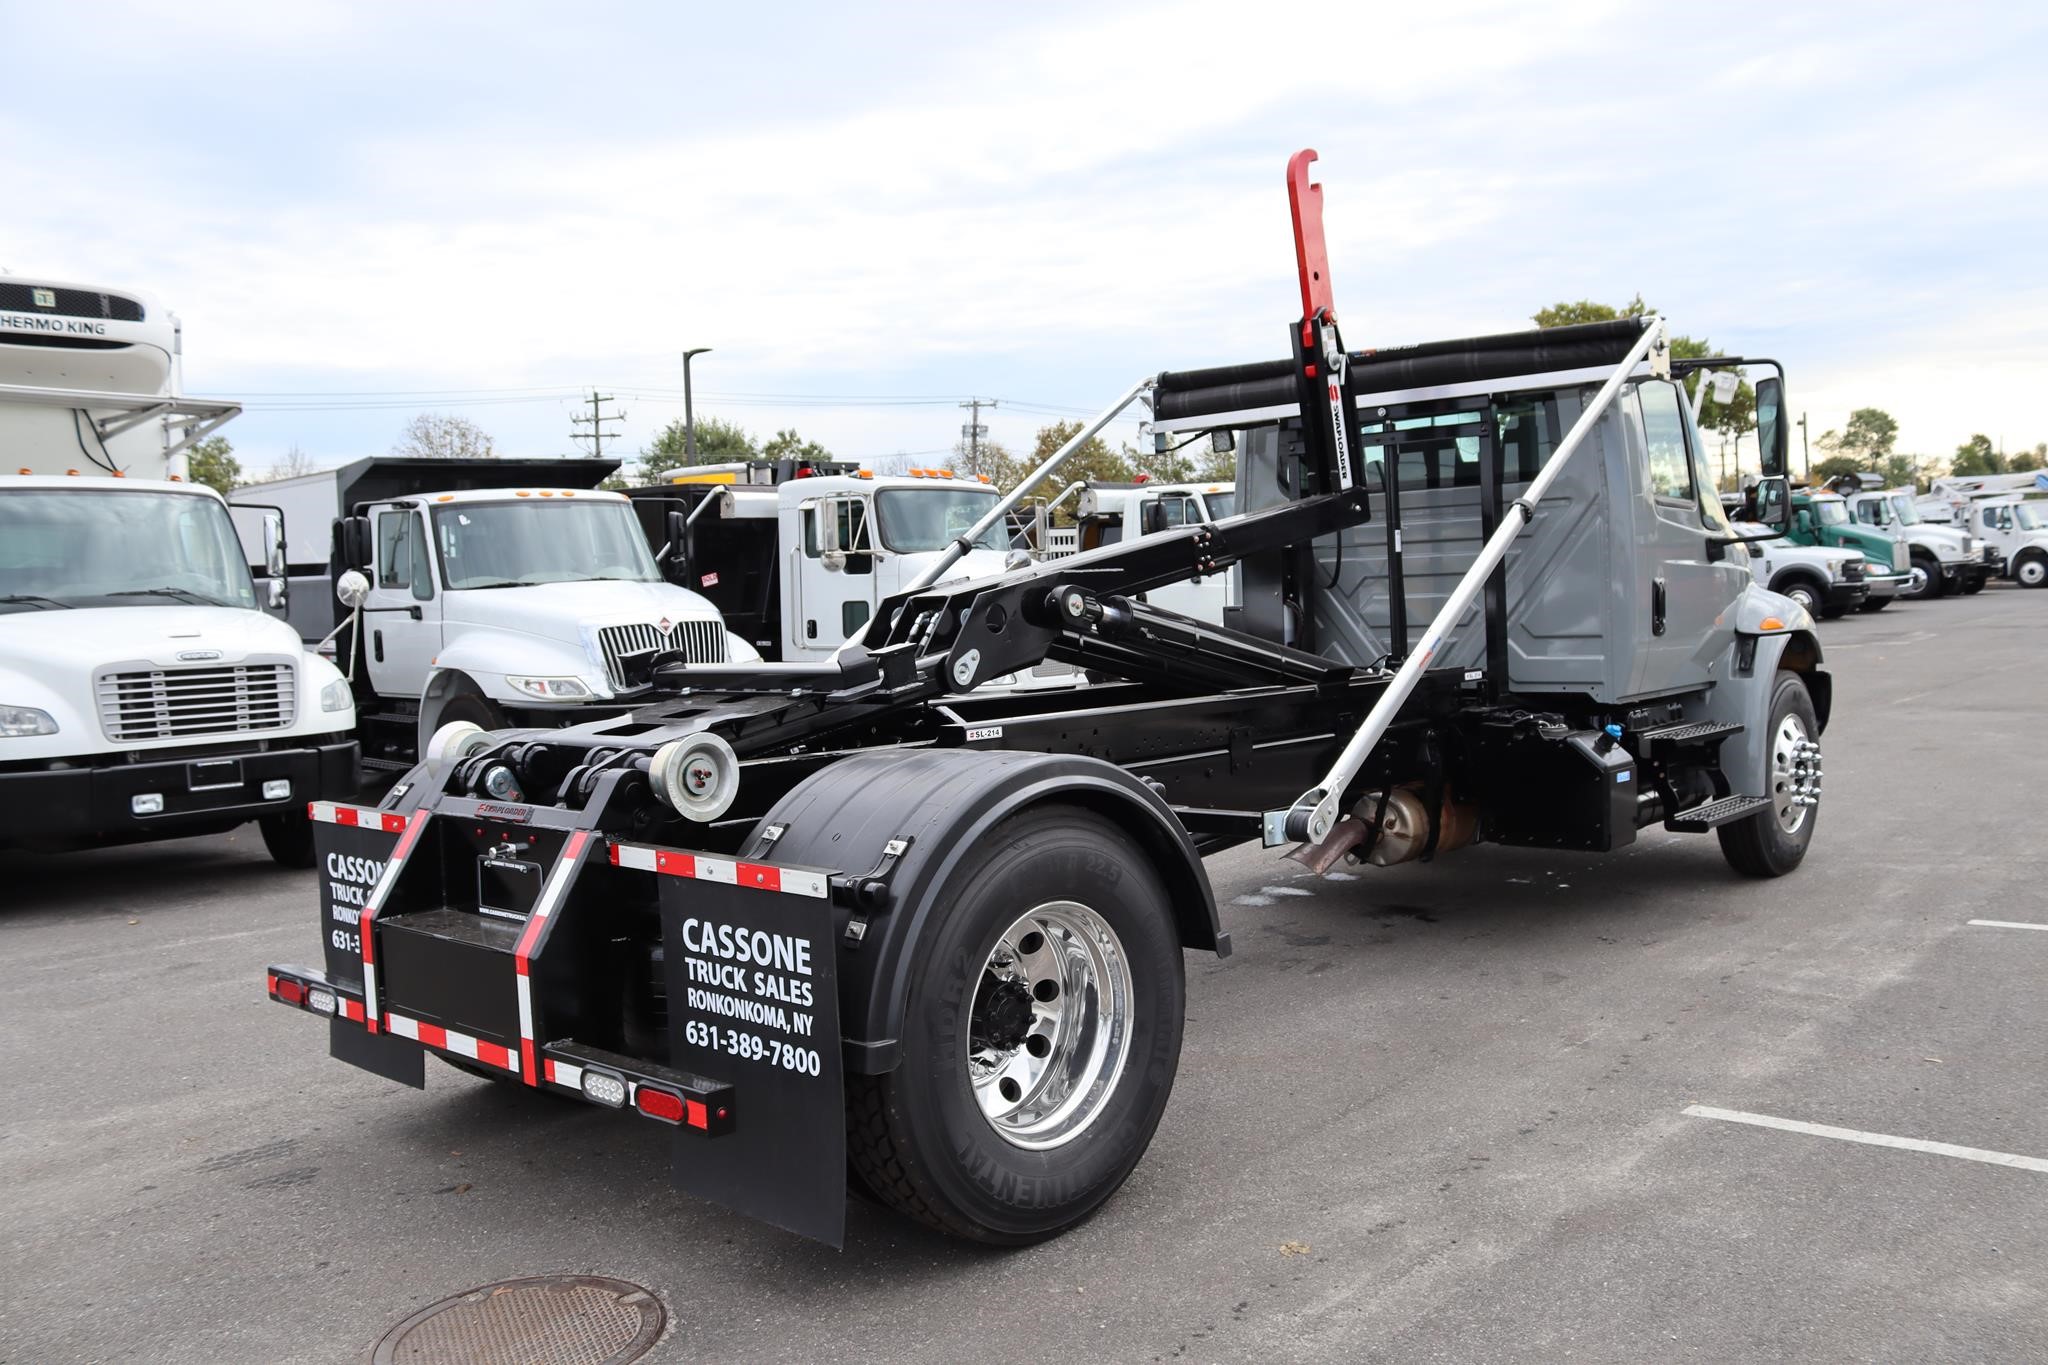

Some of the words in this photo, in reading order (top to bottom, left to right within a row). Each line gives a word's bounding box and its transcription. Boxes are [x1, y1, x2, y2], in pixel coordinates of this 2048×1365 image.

[0, 313, 63, 332] HERMO
[66, 321, 106, 335] KING
[1332, 405, 1347, 480] SWAPLOADER
[975, 729, 1000, 739] SL-214
[483, 804, 527, 817] SWAPLOADER
[327, 852, 386, 886] CASSON
[1085, 853, 1122, 883] 22.5
[329, 881, 365, 906] TRUCK
[332, 904, 361, 926] RONKO
[332, 929, 361, 954] 631-3
[682, 918, 812, 976] CASSONE
[684, 956, 748, 993] TRUCK
[753, 971, 814, 1007] SALES
[687, 987, 791, 1035] RONKONKOMA,
[793, 1012, 814, 1037] NY
[685, 1020, 821, 1078] 631-389-7800
